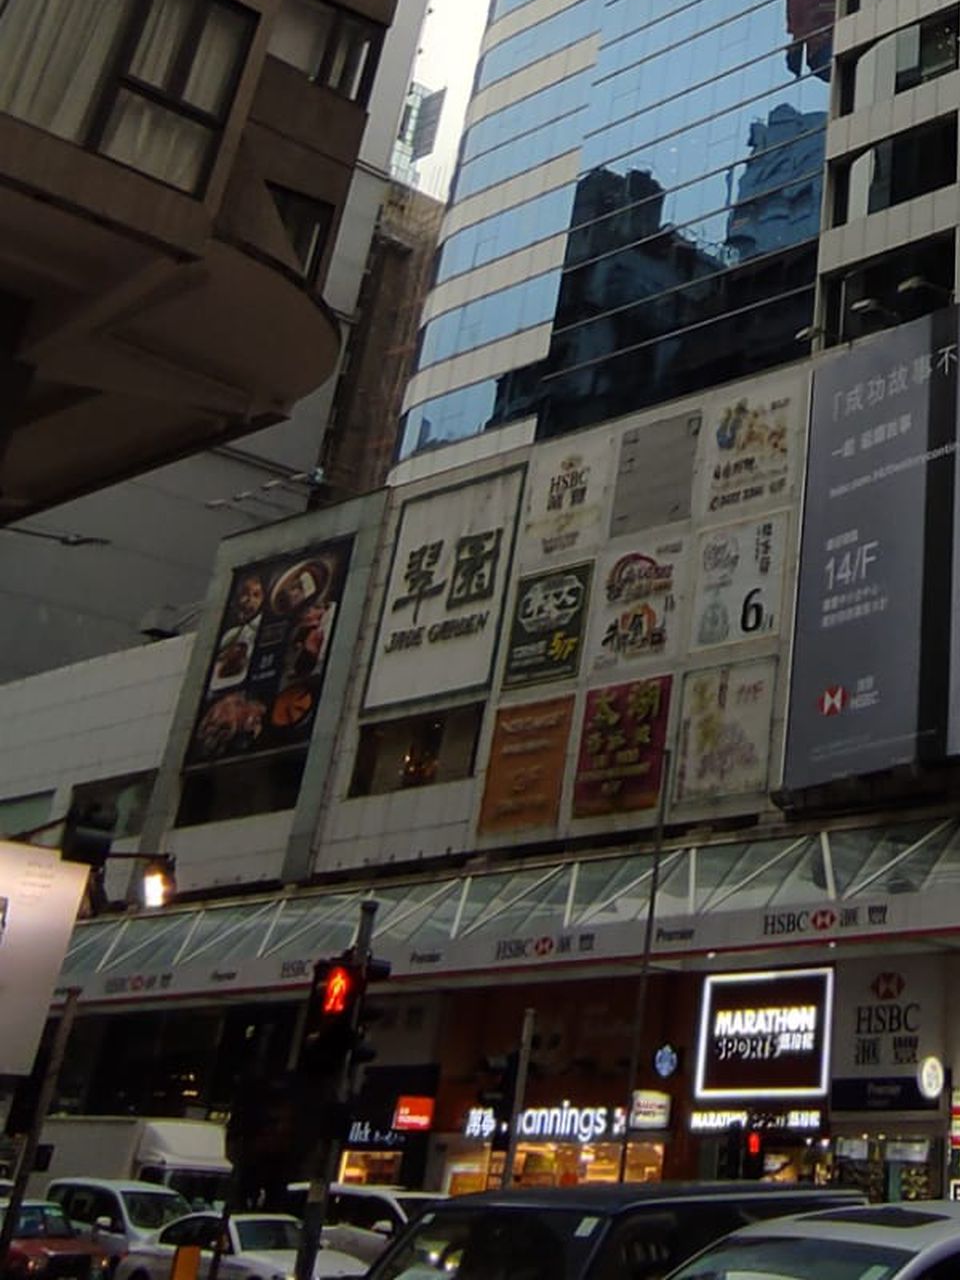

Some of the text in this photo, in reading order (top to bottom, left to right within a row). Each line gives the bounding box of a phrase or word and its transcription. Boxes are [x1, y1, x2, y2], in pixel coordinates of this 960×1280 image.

[824, 539, 880, 590] 14/F
[763, 911, 809, 936] HSBC
[495, 939, 533, 961] HSBC
[714, 1005, 817, 1038] MARATHON
[855, 1002, 921, 1035] HSBC
[502, 1099, 608, 1142] annings
